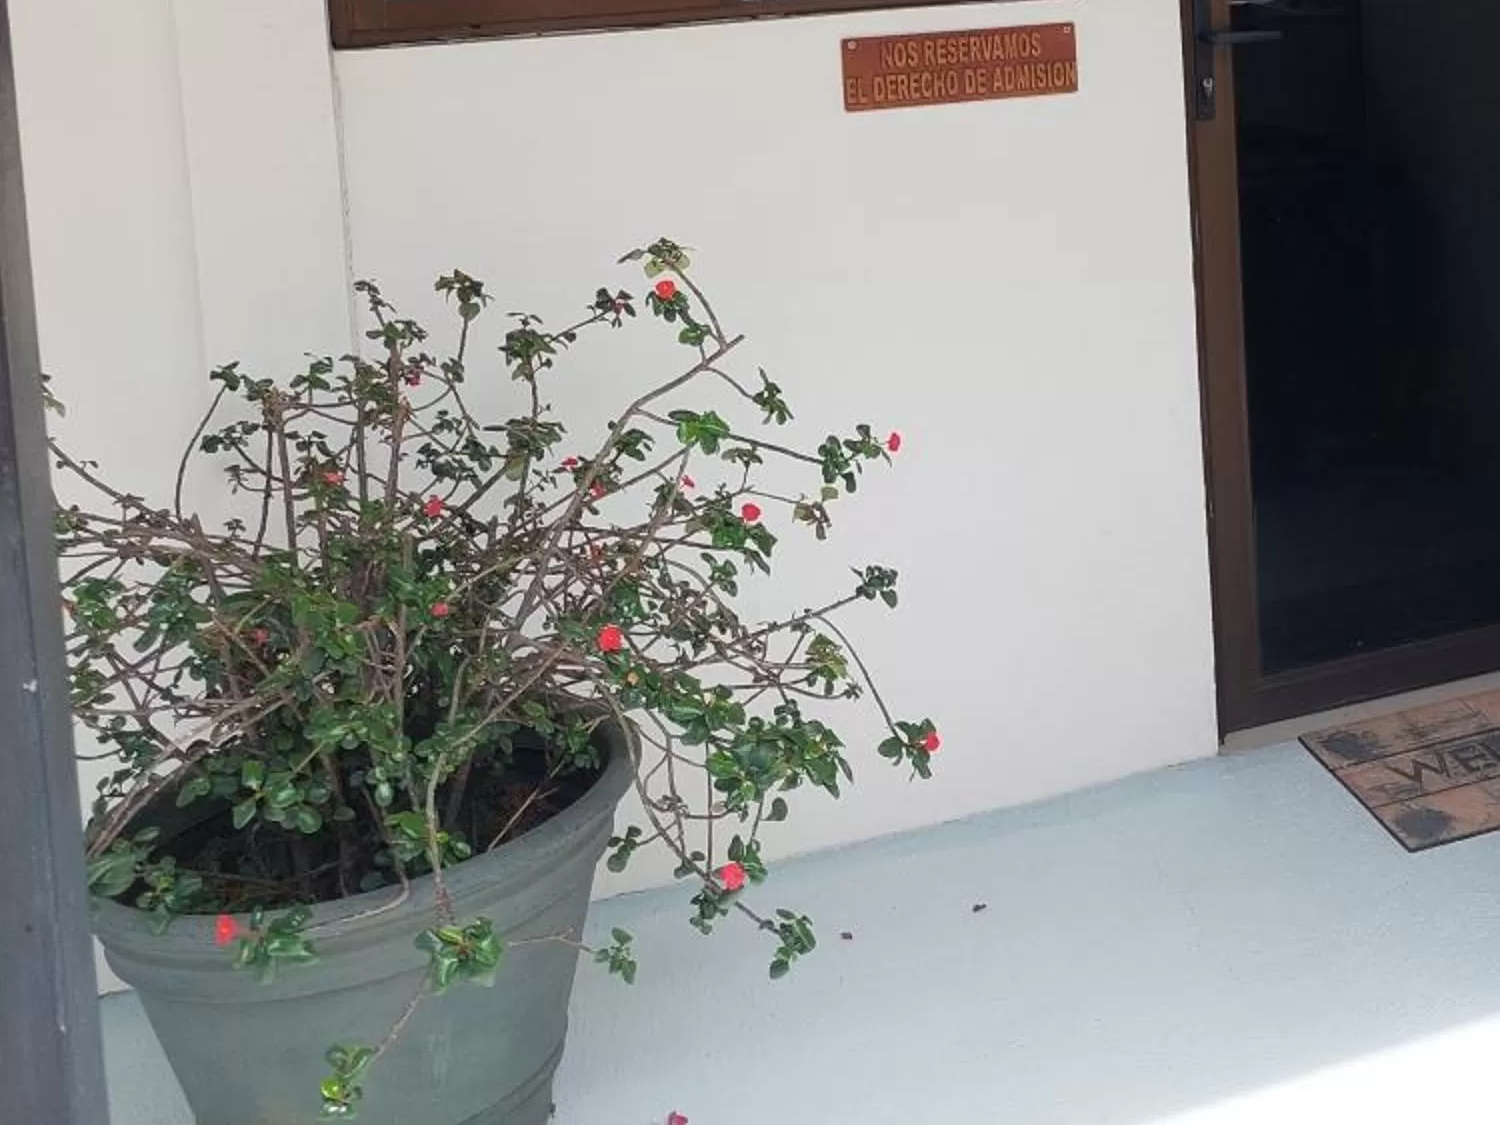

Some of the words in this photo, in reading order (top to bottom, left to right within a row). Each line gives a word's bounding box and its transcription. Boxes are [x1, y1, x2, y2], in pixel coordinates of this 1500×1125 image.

[881, 41, 919, 69] NOS
[924, 31, 1041, 68] RESERVAMOS
[847, 78, 868, 104] EL
[873, 70, 959, 102] DERECHO
[964, 68, 987, 94] DE
[993, 60, 1077, 92] ADMISION
